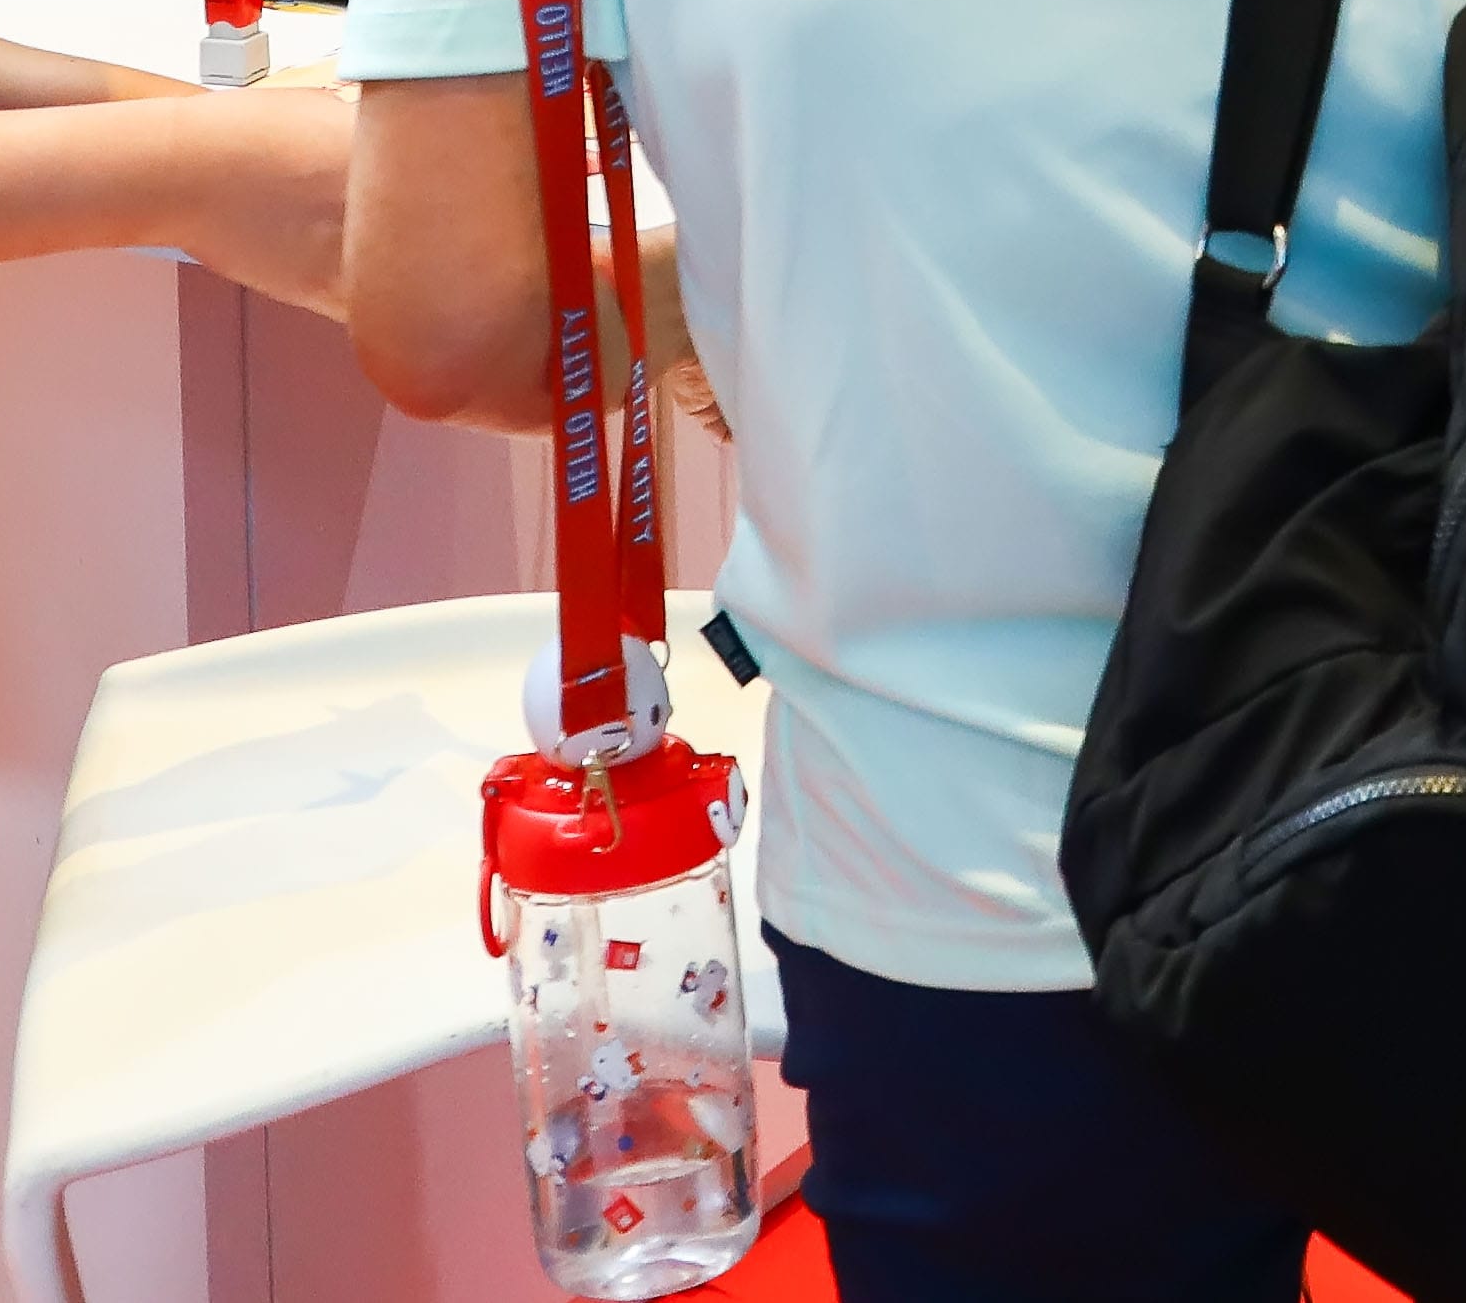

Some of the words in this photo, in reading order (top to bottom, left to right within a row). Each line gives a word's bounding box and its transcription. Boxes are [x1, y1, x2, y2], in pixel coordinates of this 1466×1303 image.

[535, 3, 575, 98] HELLO
[561, 308, 594, 404] KITTY
[564, 409, 599, 505] HELLO
[632, 454, 655, 545] KITTY
